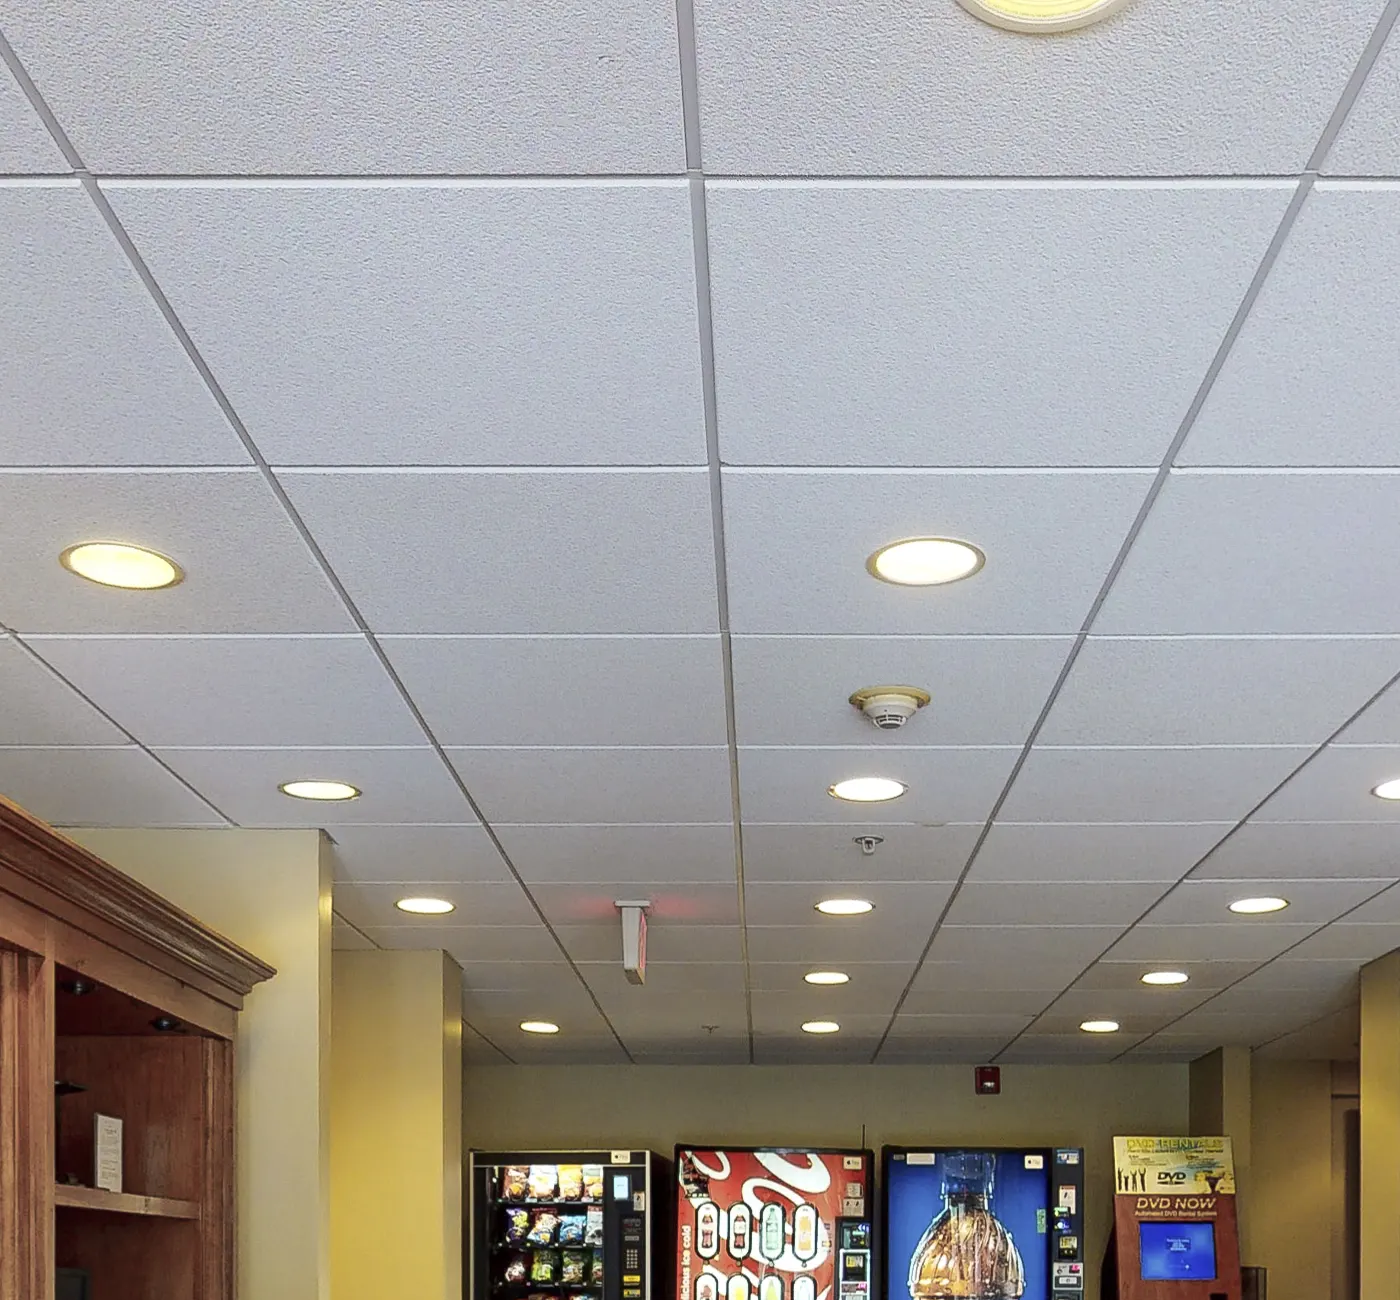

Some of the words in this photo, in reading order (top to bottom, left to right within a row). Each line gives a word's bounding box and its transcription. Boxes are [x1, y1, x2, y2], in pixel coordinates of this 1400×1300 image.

[1157, 1171, 1187, 1182] DVD
[1136, 1197, 1171, 1209] DVD
[1174, 1197, 1217, 1209] NOW
[682, 1225, 692, 1249] cold
[681, 1249, 691, 1266] ice
